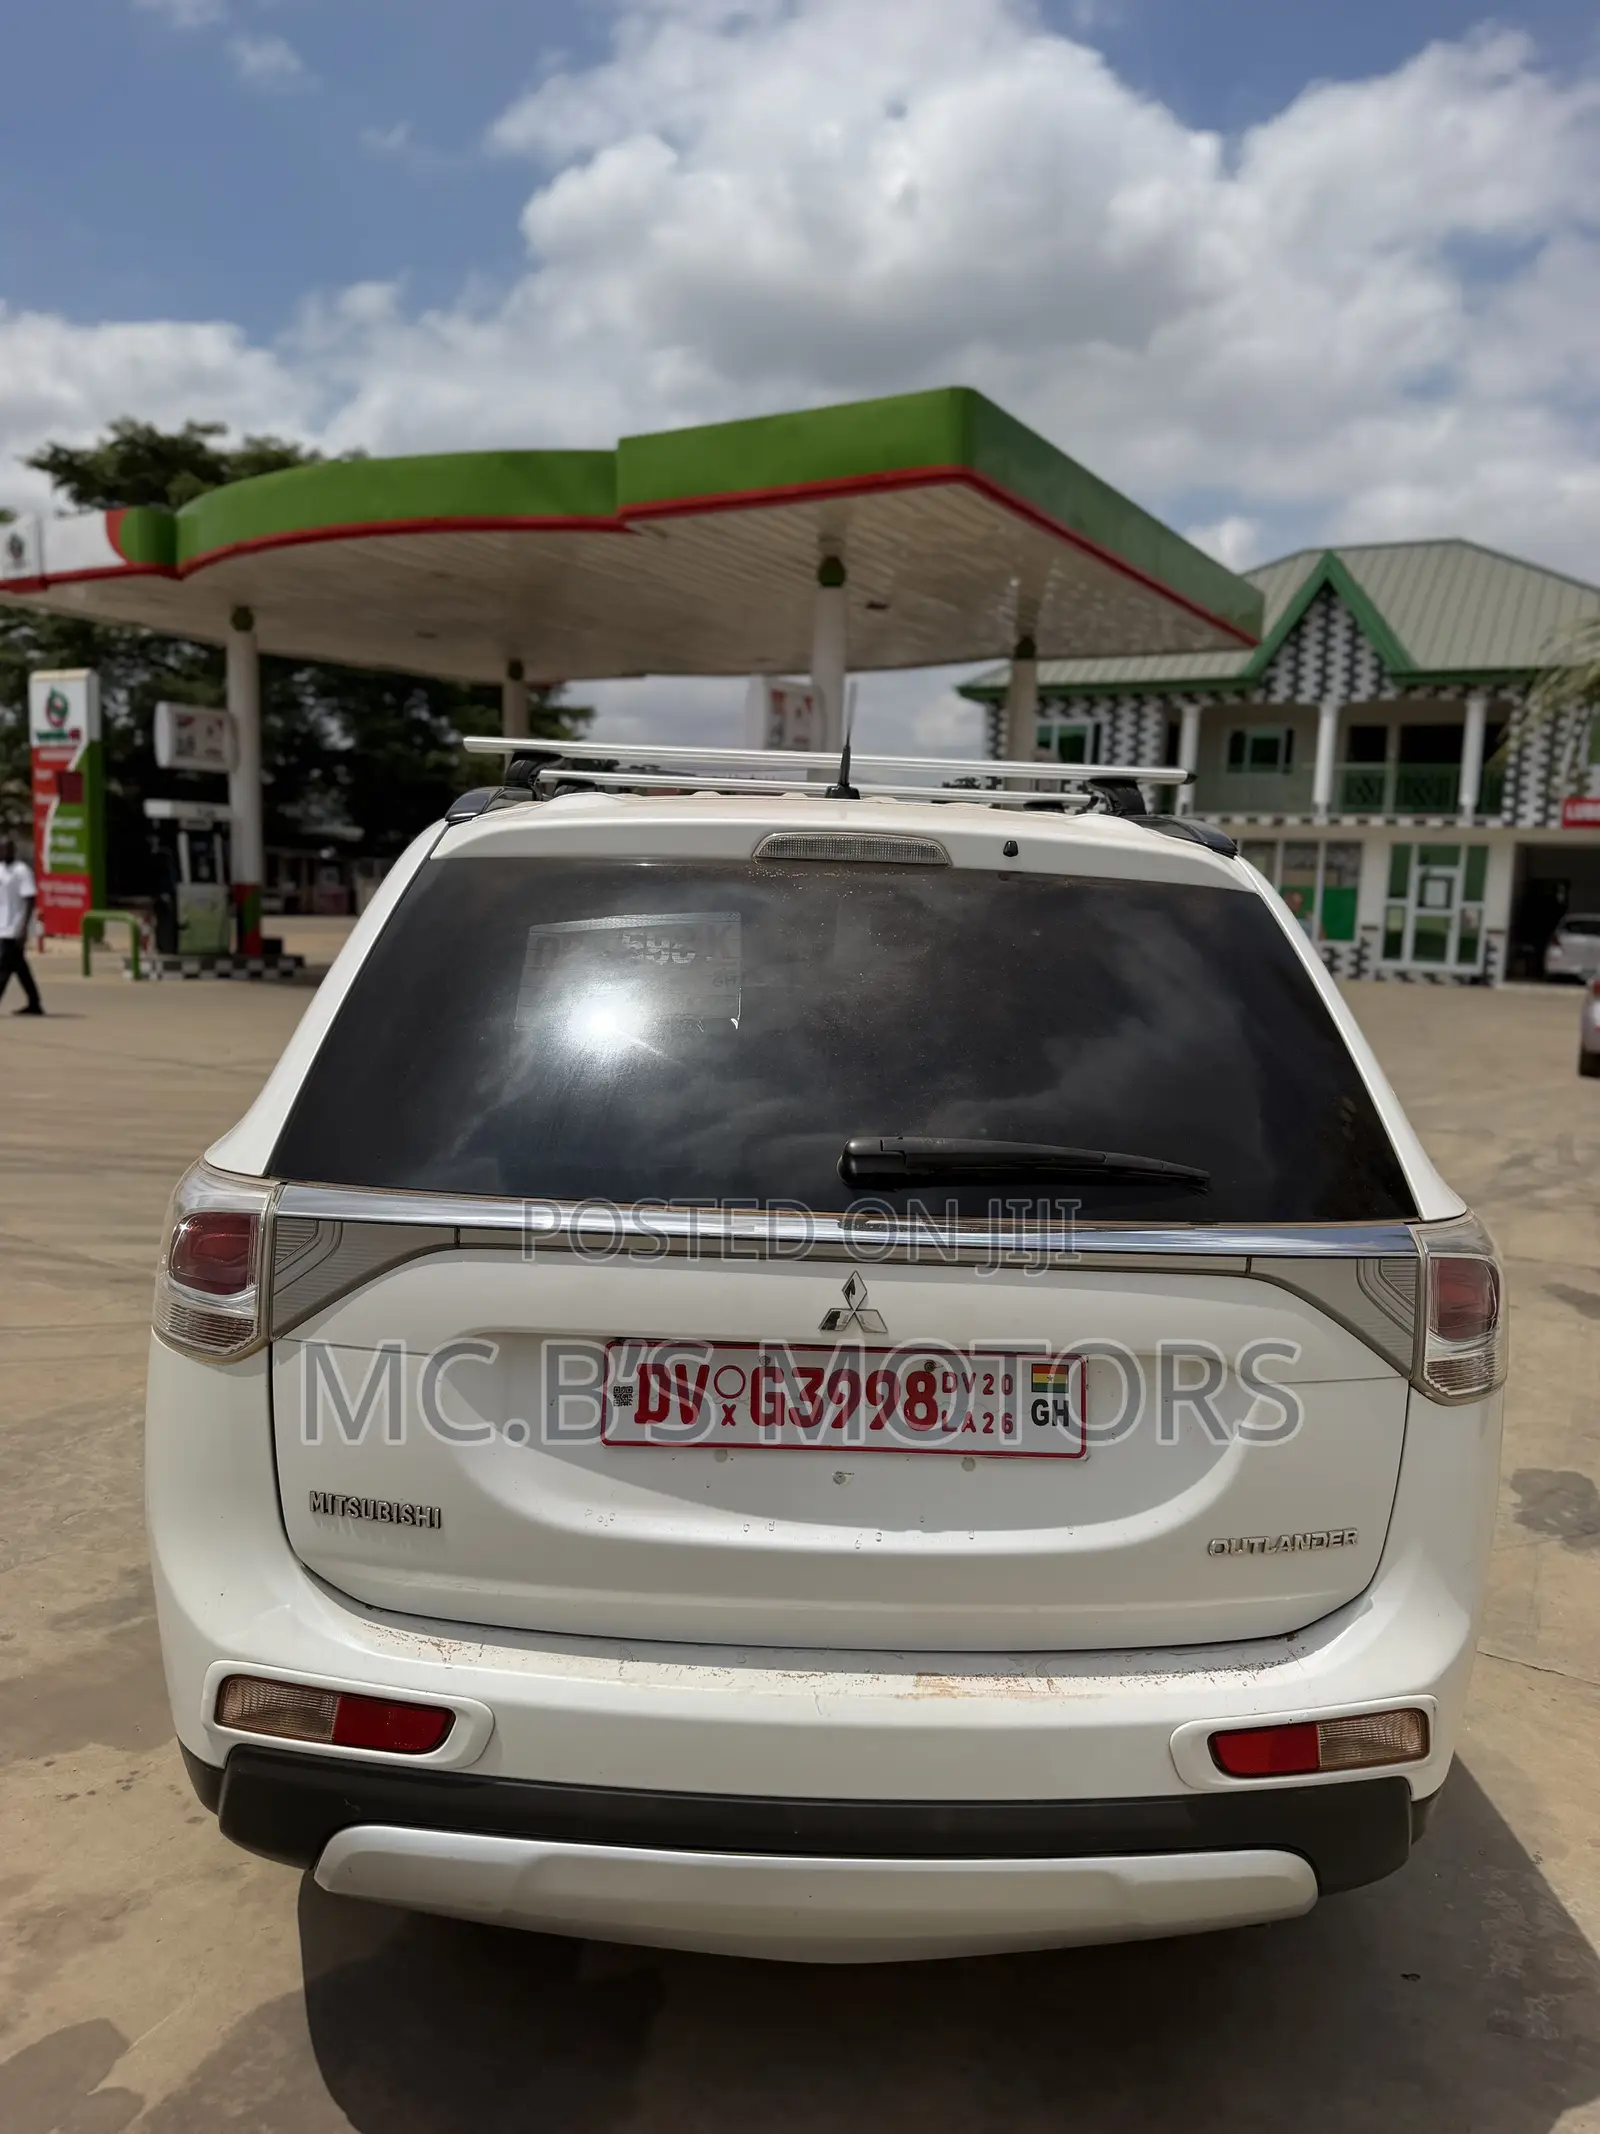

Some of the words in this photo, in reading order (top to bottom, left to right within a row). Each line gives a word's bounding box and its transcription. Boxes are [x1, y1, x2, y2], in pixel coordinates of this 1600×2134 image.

[634, 1363, 710, 1426] DV
[750, 1365, 939, 1432] G3998
[1030, 1398, 1070, 1428] GH
[309, 1490, 442, 1530] MITSUBISHI
[1207, 1527, 1359, 1557] OUTLANDER
